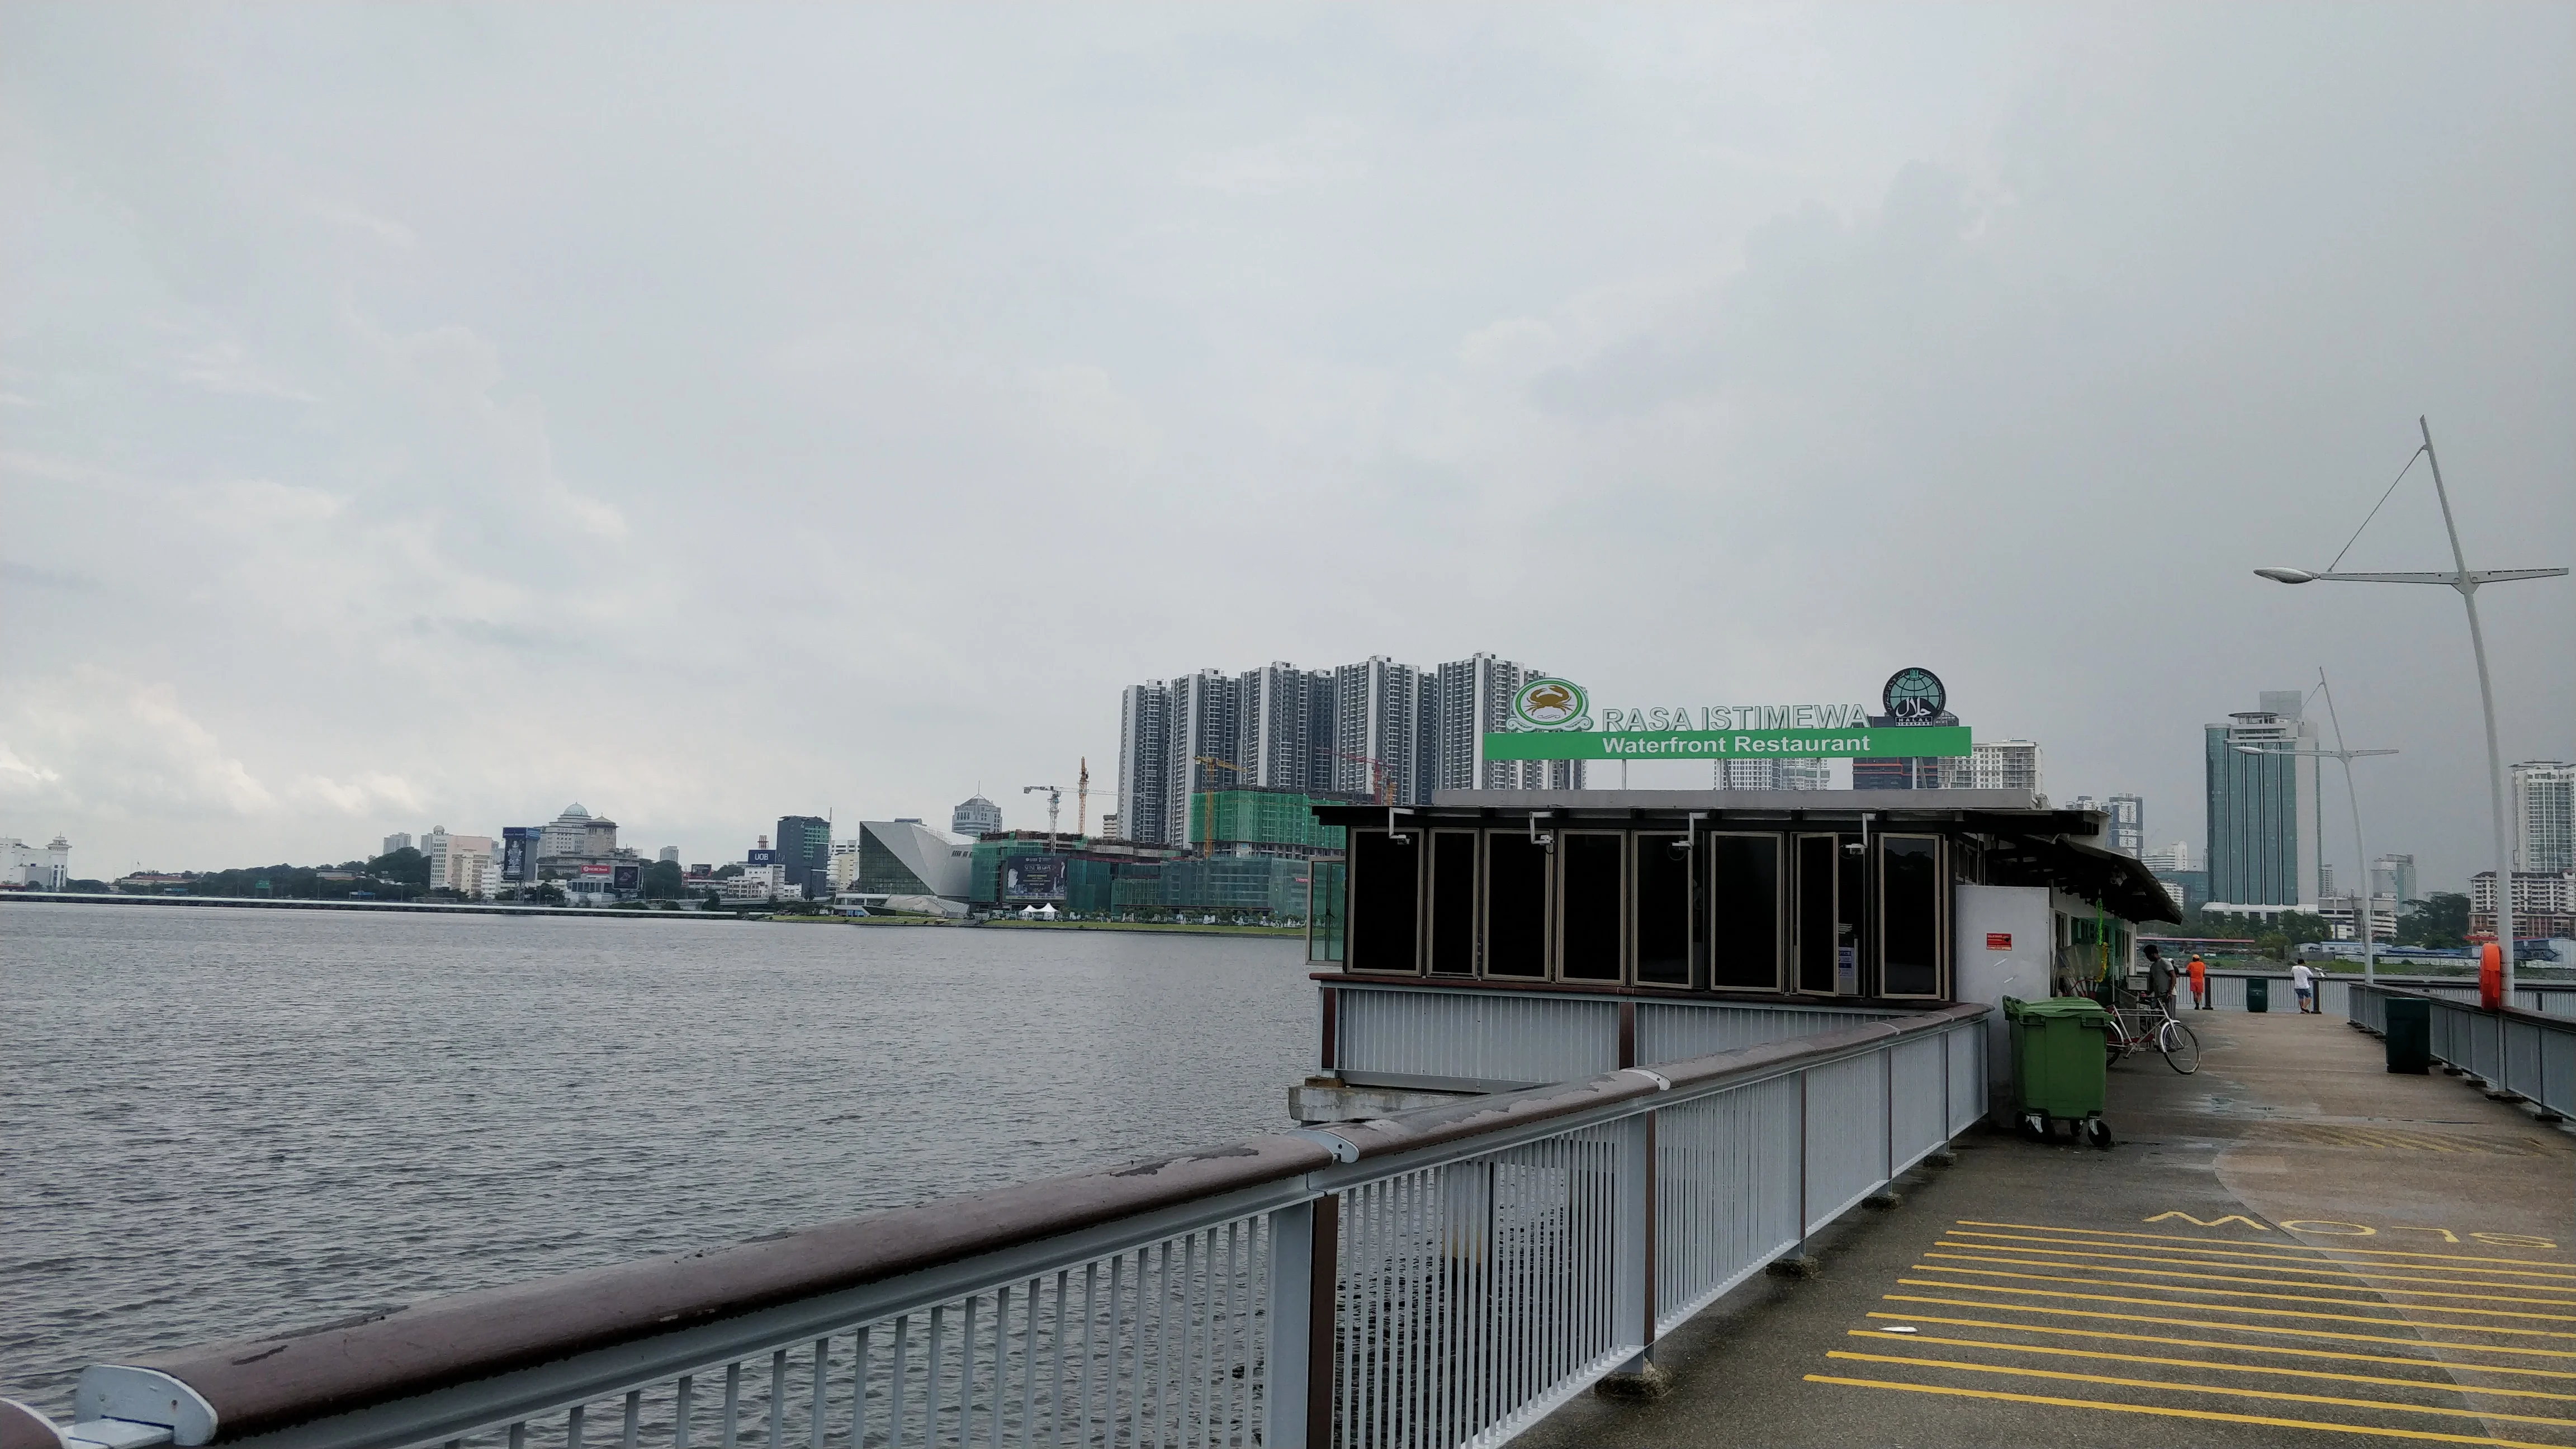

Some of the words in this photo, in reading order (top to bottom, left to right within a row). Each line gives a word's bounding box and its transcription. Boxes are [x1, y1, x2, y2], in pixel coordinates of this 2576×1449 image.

[1602, 707, 1693, 732] RASA
[1702, 704, 1871, 731] ISTIMEWA
[1895, 696, 1931, 718] حلال
[1602, 736, 1726, 753] Waterfront
[1734, 735, 1871, 752] Restaurant
[2143, 1211, 2558, 1248] SLOW
